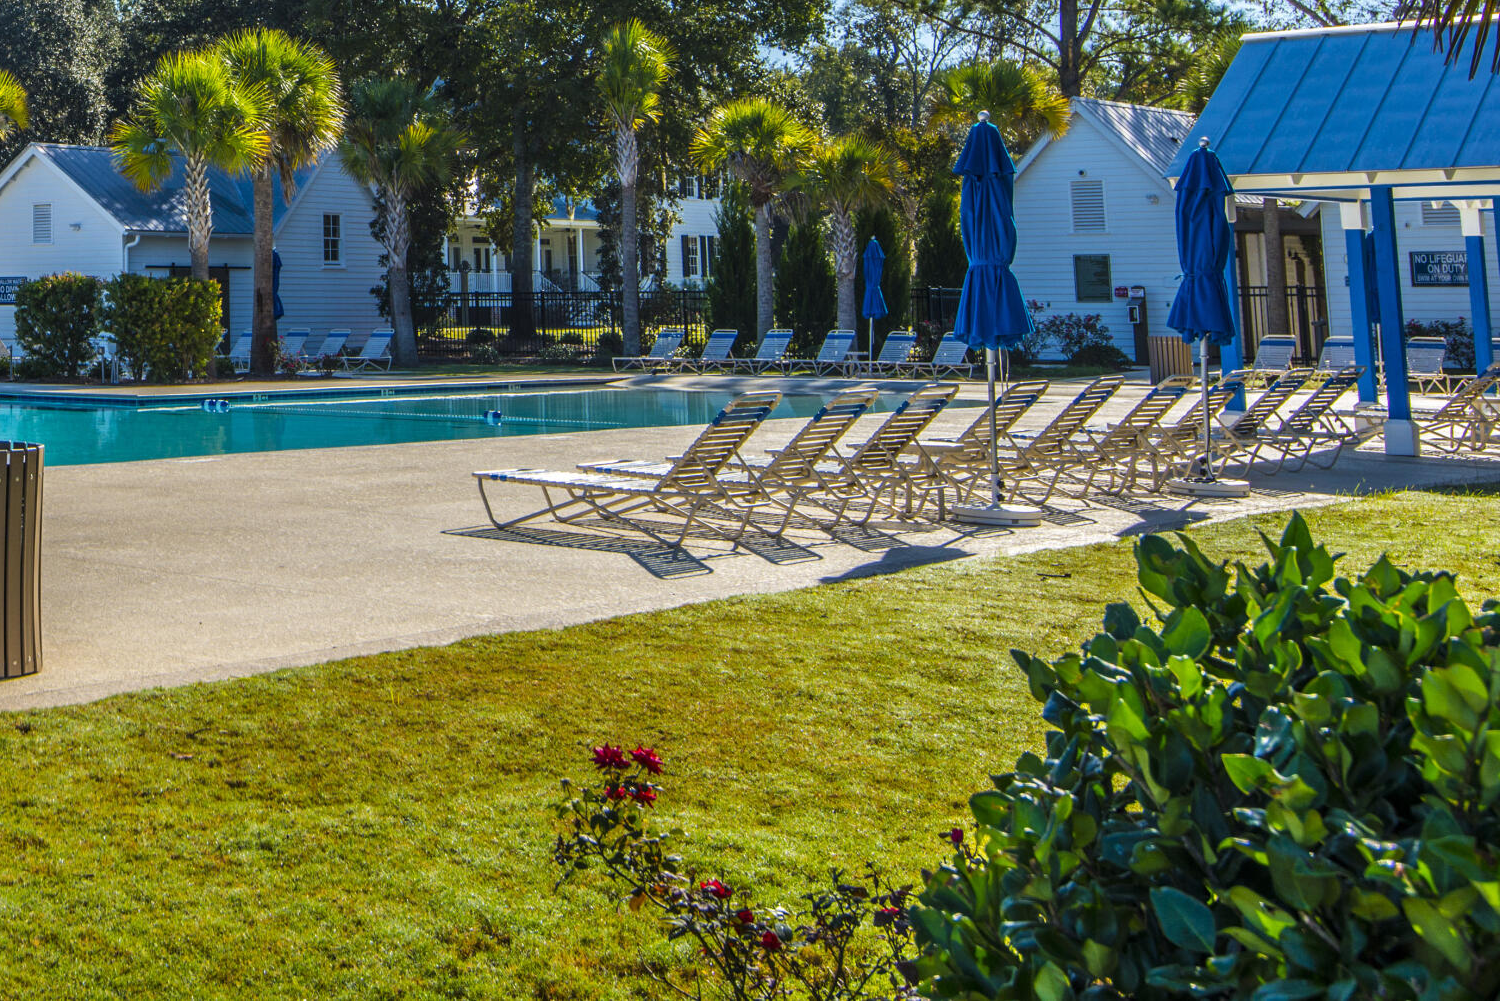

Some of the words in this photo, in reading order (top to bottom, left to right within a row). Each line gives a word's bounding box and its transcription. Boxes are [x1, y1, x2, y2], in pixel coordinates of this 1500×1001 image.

[1414, 254, 1427, 263] NO
[1429, 253, 1467, 263] LIFEGUA
[1427, 264, 1440, 273] ON
[1442, 264, 1465, 273] DUTY
